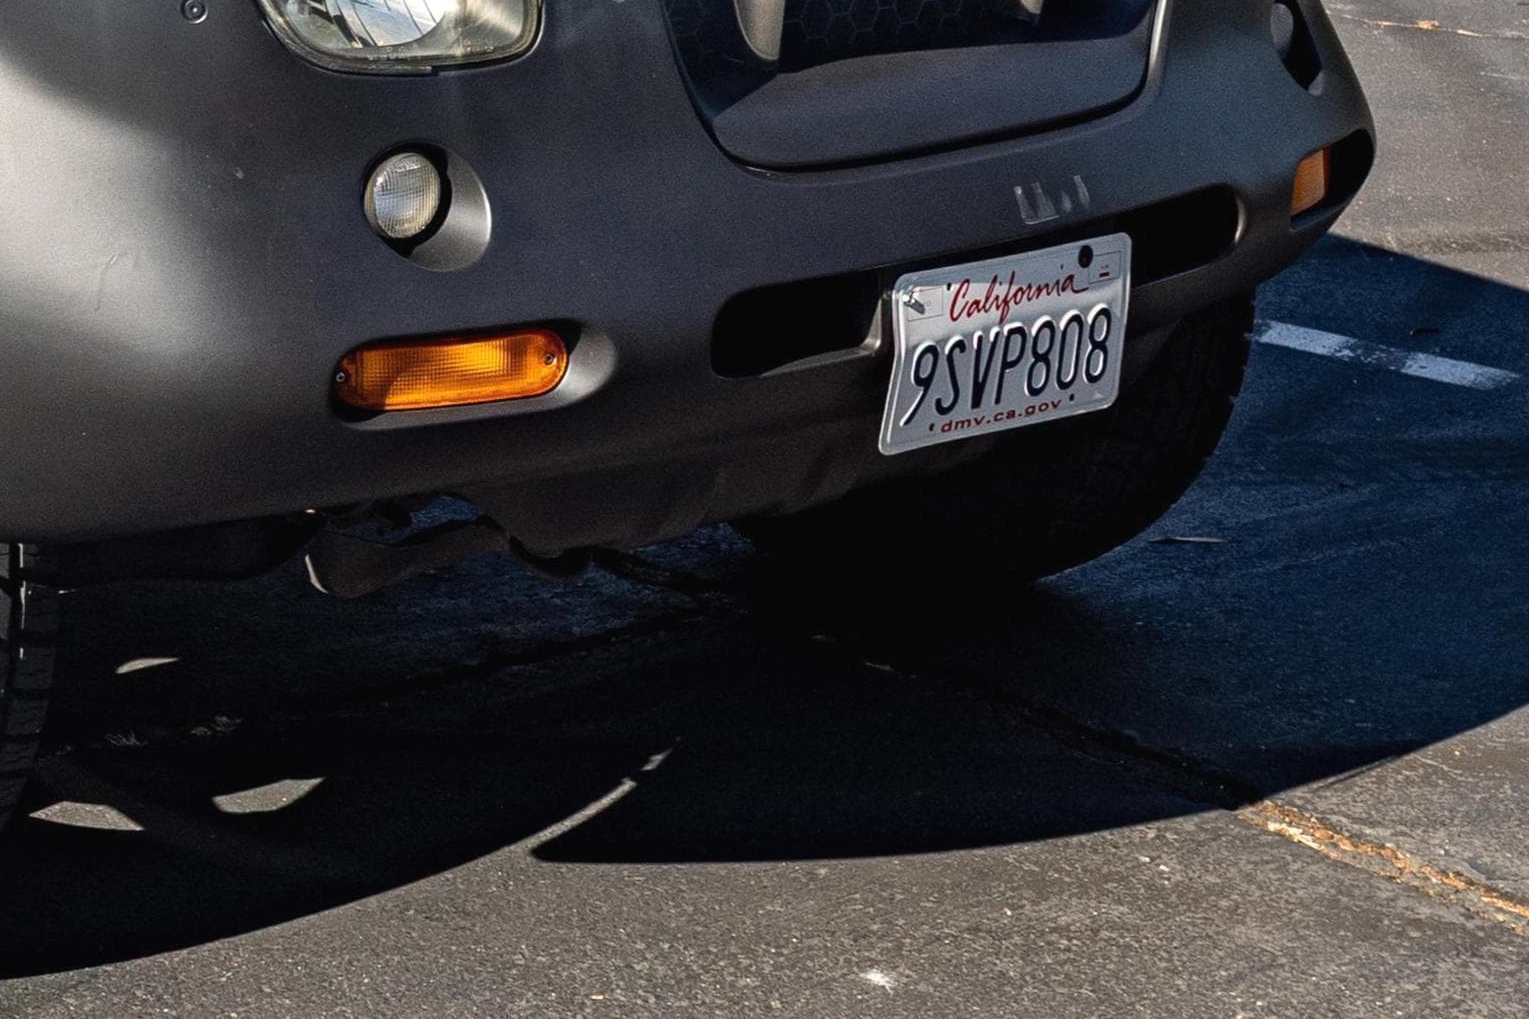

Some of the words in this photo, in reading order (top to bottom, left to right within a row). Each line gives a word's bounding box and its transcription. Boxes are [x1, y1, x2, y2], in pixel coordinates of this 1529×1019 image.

[949, 270, 1090, 324] California
[899, 303, 1113, 428] 9SVP808
[940, 397, 1064, 434] dmv.ca.gov
